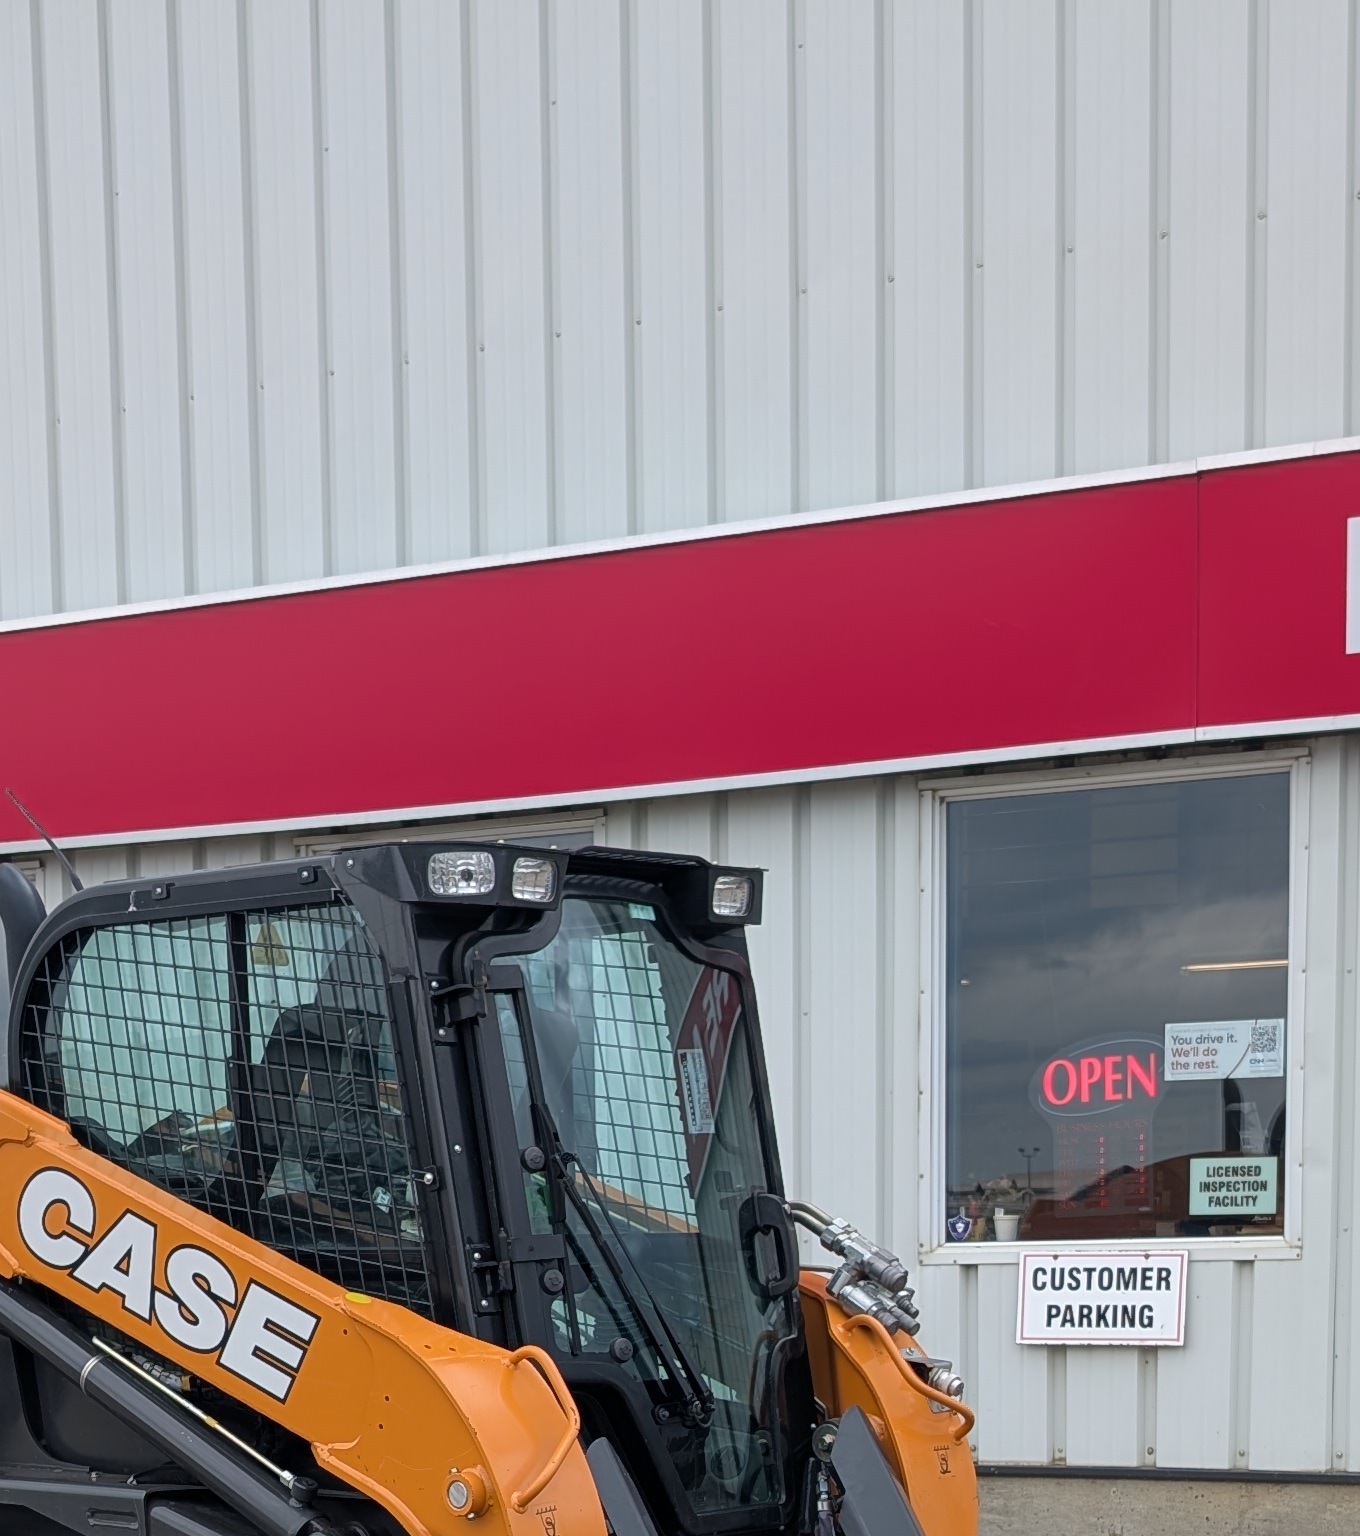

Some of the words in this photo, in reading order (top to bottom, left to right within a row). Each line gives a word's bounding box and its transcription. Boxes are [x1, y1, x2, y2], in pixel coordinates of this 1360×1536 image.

[1170, 1035, 1192, 1046] You
[1195, 1033, 1224, 1044] drive
[1226, 1032, 1238, 1043] it.
[1170, 1047, 1199, 1058] We'll
[1202, 1046, 1218, 1057] do
[1170, 1060, 1190, 1071] the
[1193, 1059, 1219, 1070] rest.
[1042, 1052, 1157, 1106] OPEN
[1206, 1165, 1262, 1178] LICENSED
[1198, 1179, 1268, 1193] INSPECTION
[1207, 1195, 1259, 1208] FACILITY
[19, 1166, 321, 1403] CASE
[1031, 1268, 1172, 1294] CUSTOMER
[1045, 1304, 1155, 1330] PARKING
